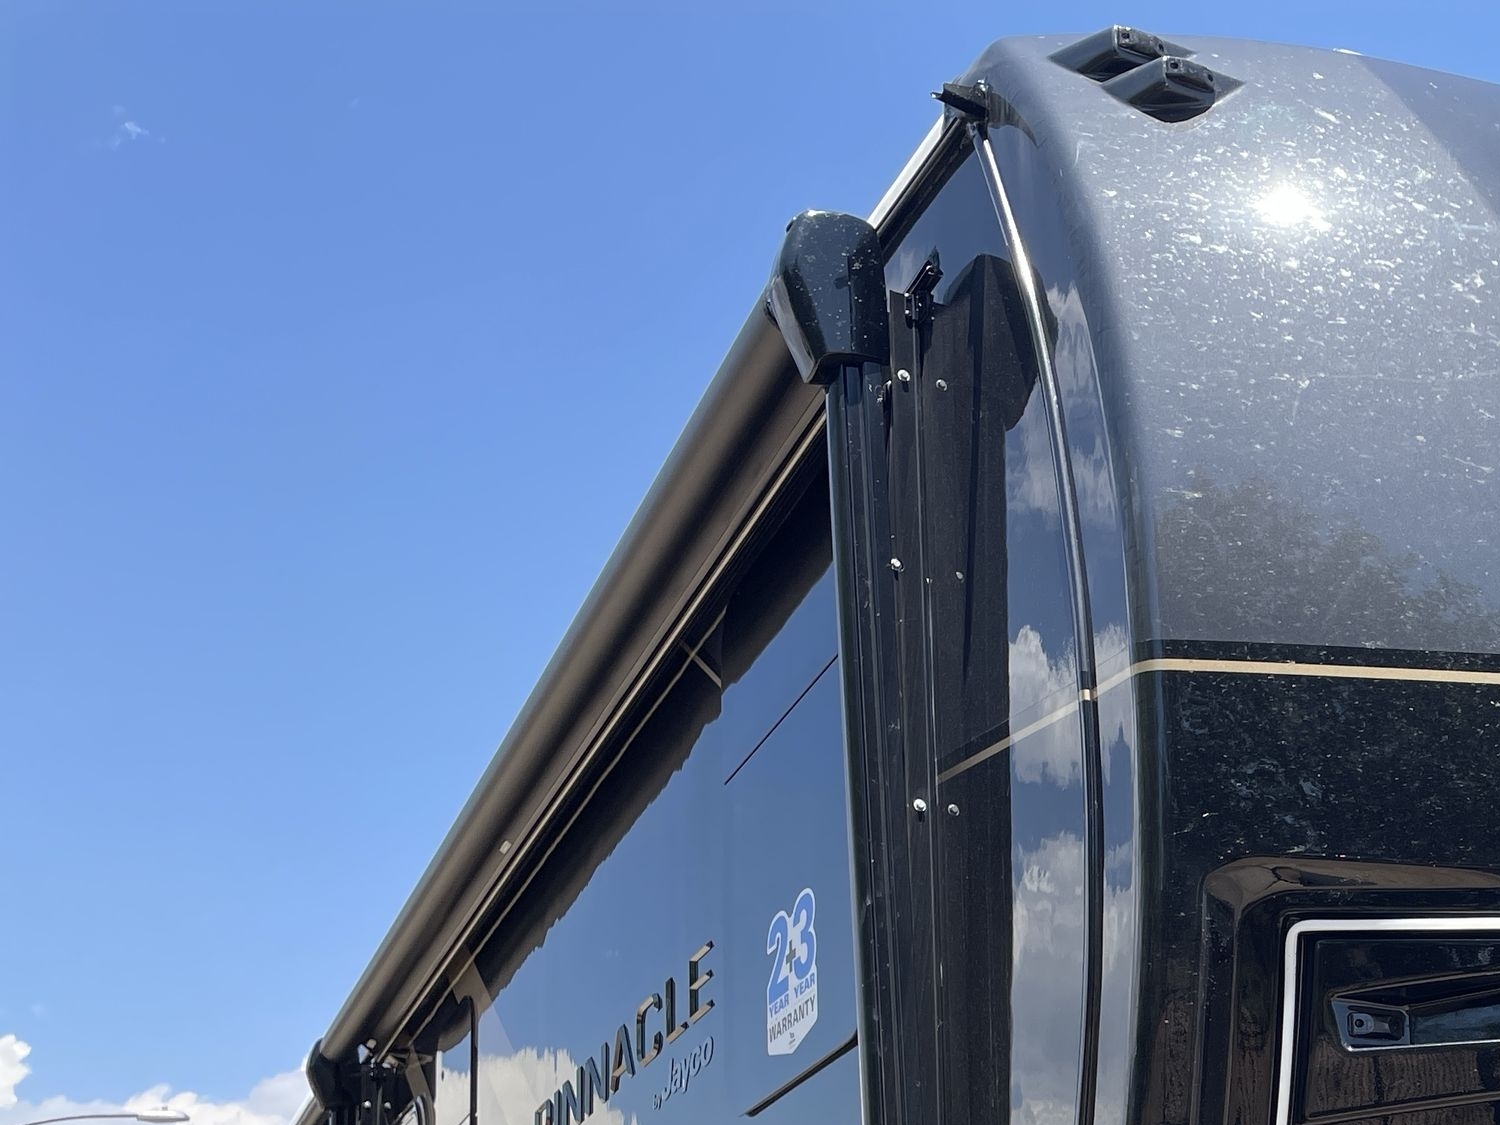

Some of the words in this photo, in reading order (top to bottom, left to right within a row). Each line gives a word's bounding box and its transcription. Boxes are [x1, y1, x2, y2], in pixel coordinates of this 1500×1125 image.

[769, 993, 789, 1018] YEAR
[794, 972, 815, 999] YEAR
[769, 995, 816, 1043] WARRANTY
[664, 1036, 714, 1102] Jayco
